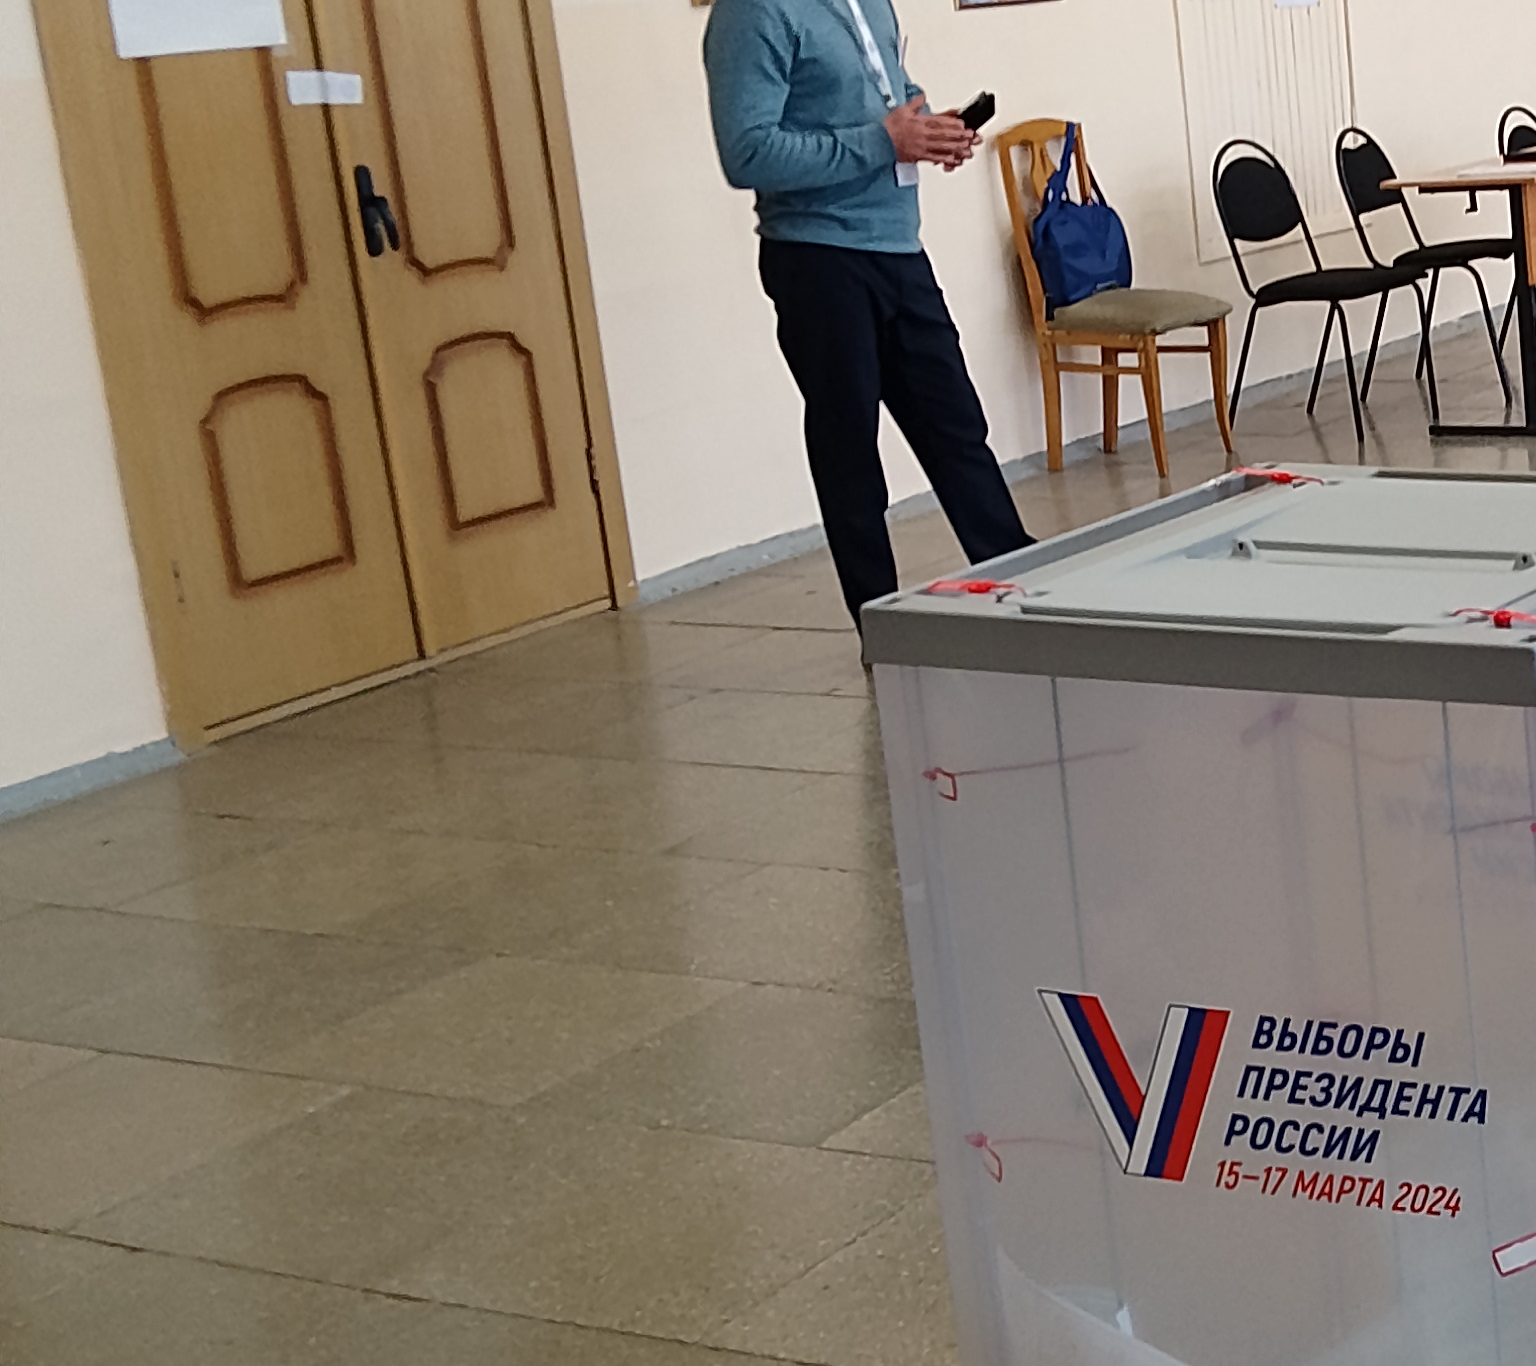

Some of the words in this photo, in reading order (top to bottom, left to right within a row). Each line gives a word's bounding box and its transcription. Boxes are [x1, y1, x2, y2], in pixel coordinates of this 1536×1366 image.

[1251, 1014, 1426, 1068] ВЫБОРЫ
[1236, 1064, 1489, 1125] ПРЕЗИДЕНТА
[1223, 1112, 1381, 1164] РОССИИ
[1292, 1170, 1385, 1210] МАРТА
[1390, 1181, 1463, 1219] 2024
